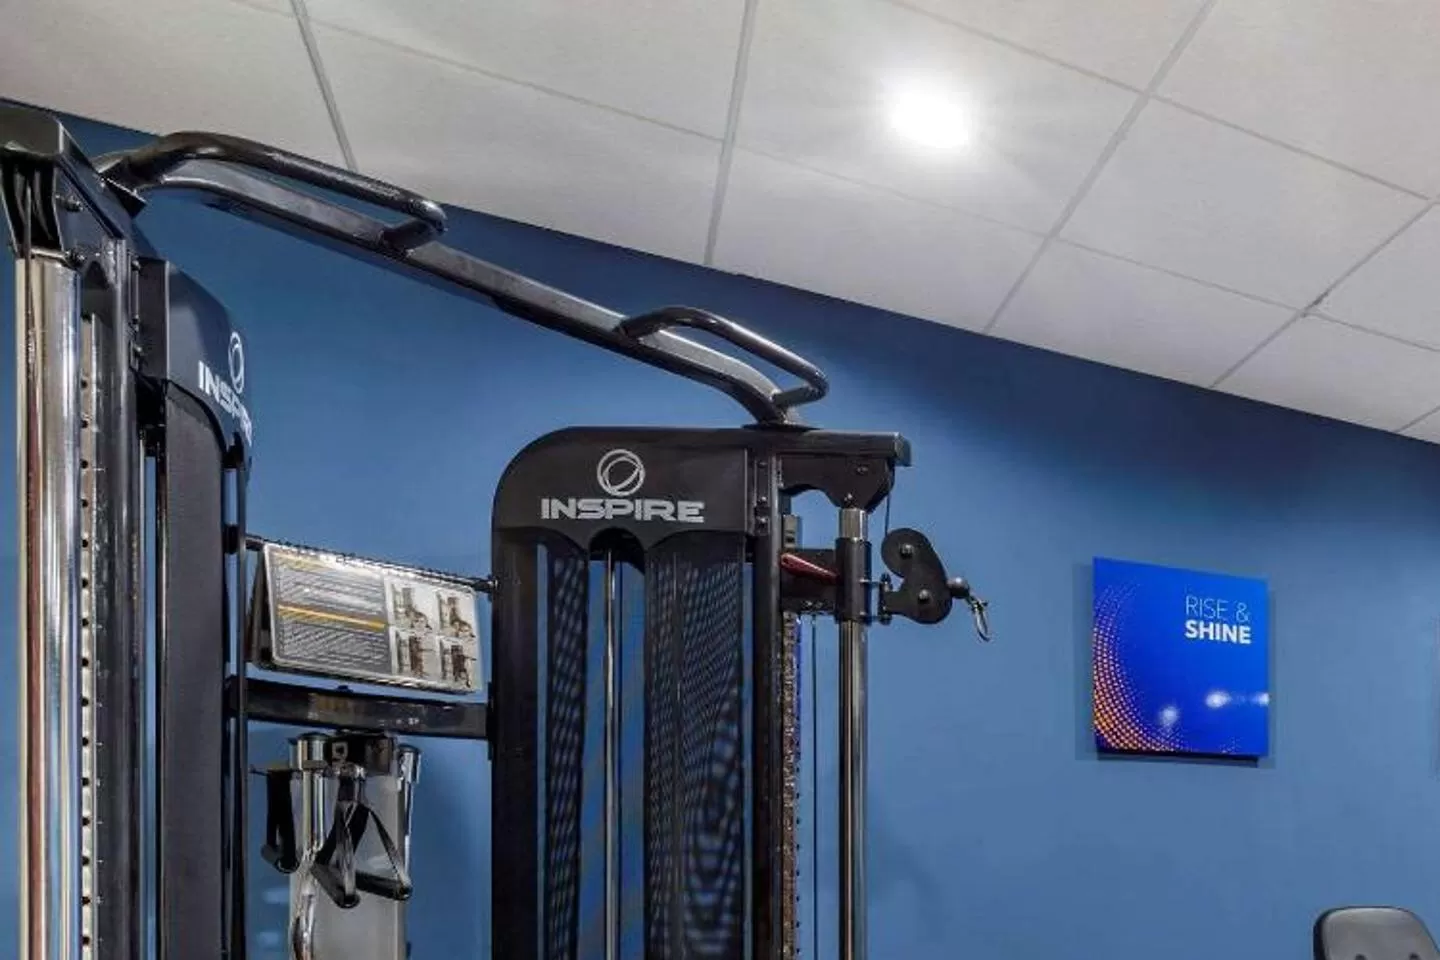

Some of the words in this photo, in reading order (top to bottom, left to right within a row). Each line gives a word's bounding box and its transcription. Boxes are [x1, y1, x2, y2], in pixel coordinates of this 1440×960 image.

[541, 498, 704, 523] INSPIRE
[1185, 595, 1229, 619] RISE
[1236, 602, 1249, 623] &
[1184, 619, 1251, 644] SHINE
